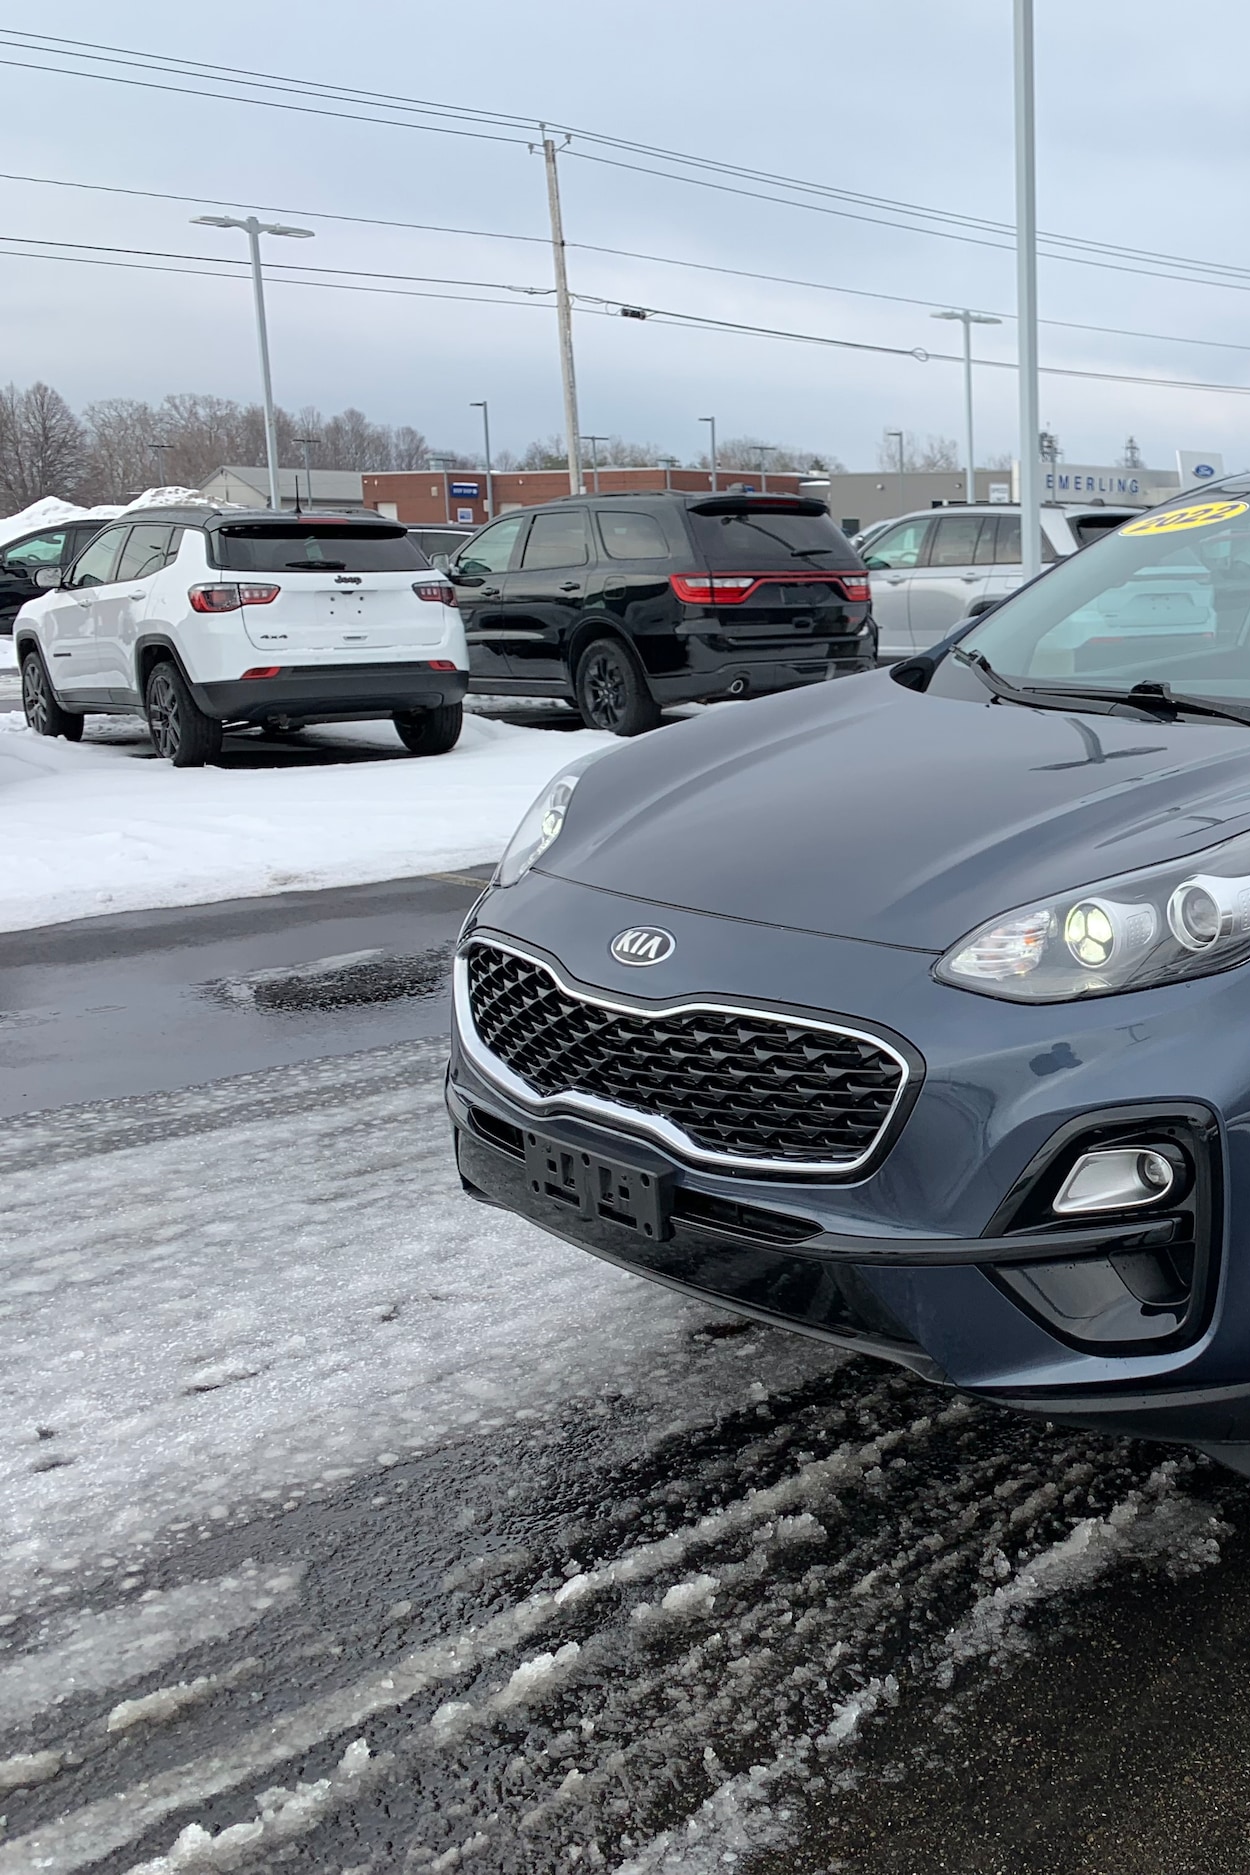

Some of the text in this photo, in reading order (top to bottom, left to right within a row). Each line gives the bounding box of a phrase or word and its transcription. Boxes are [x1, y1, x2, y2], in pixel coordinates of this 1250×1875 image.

[1046, 474, 1139, 494] EMERLING
[1128, 504, 1240, 533] 2022
[334, 575, 362, 585] Jeep
[615, 930, 663, 959] KIA
